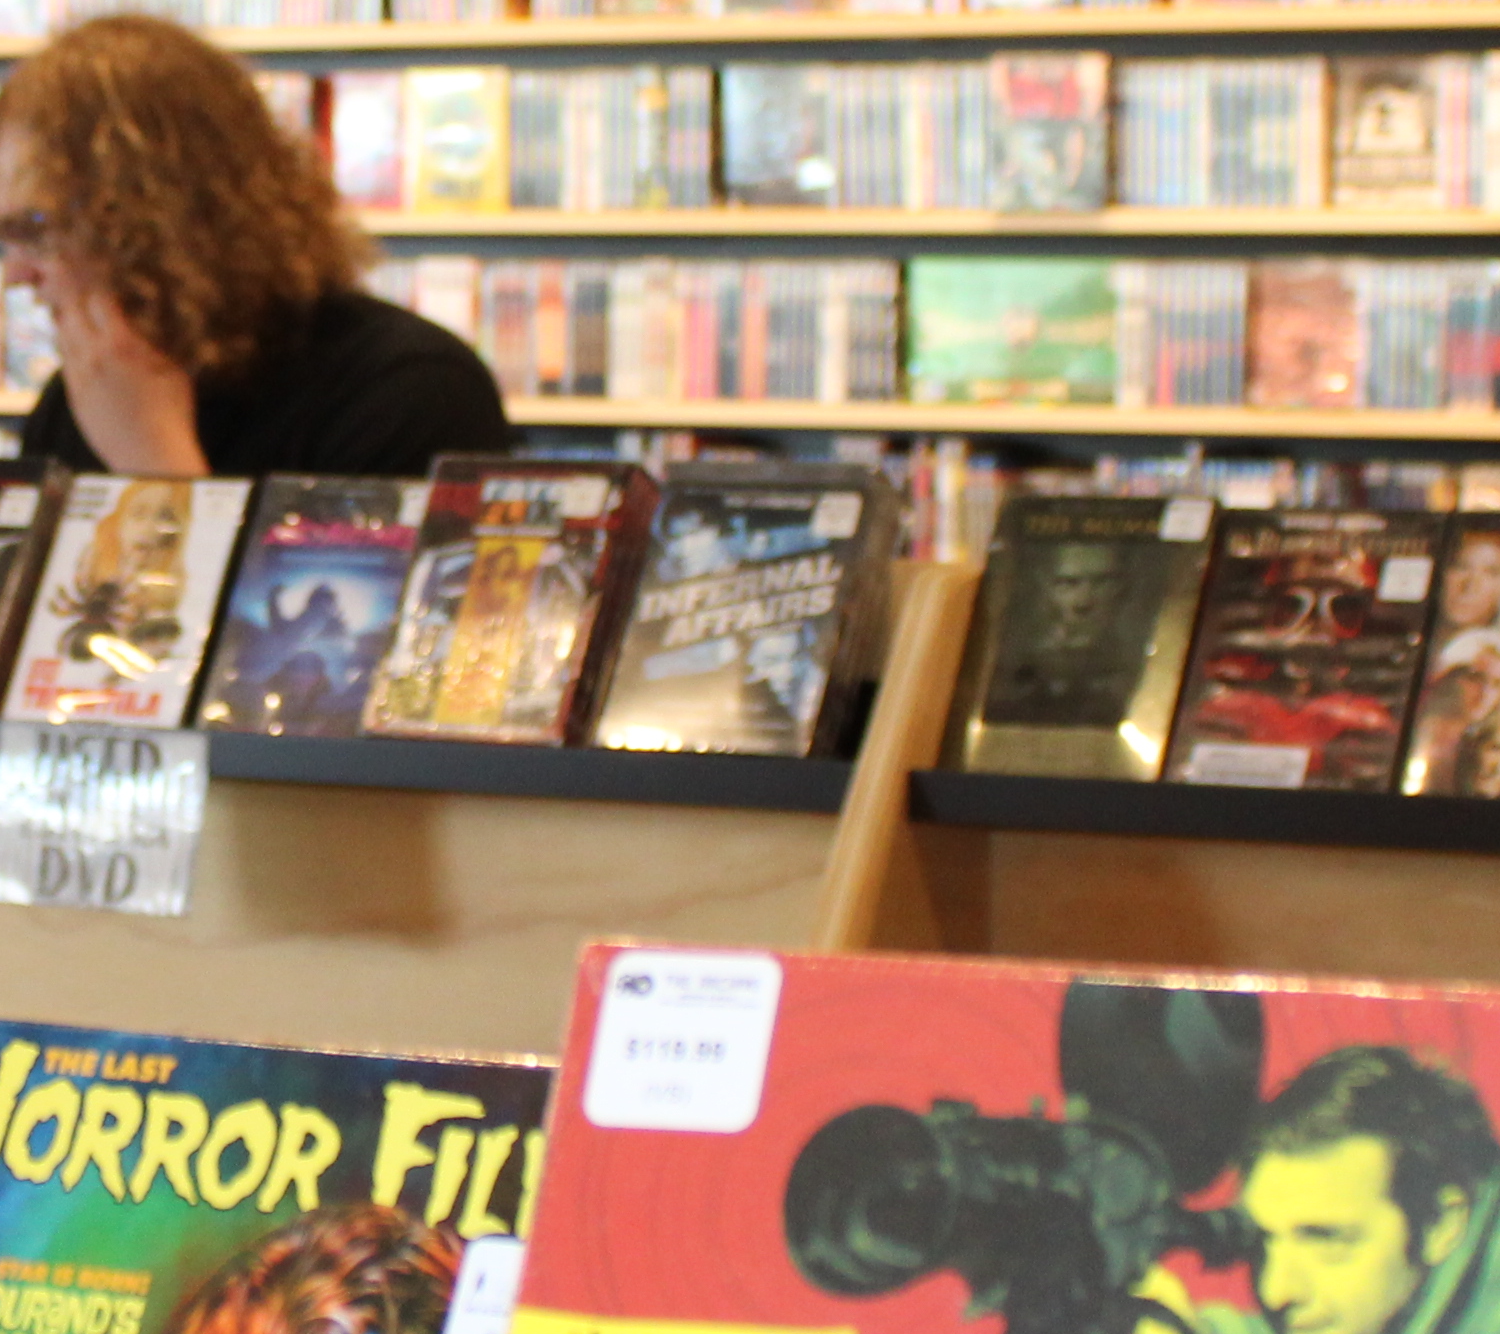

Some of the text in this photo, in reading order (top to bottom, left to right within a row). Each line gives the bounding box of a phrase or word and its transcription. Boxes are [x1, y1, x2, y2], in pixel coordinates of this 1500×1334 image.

[638, 554, 844, 624] INFERNAL
[662, 585, 836, 647] AFFAIRS
[36, 845, 137, 904] DVD
[43, 1047, 177, 1084] THE LAST
